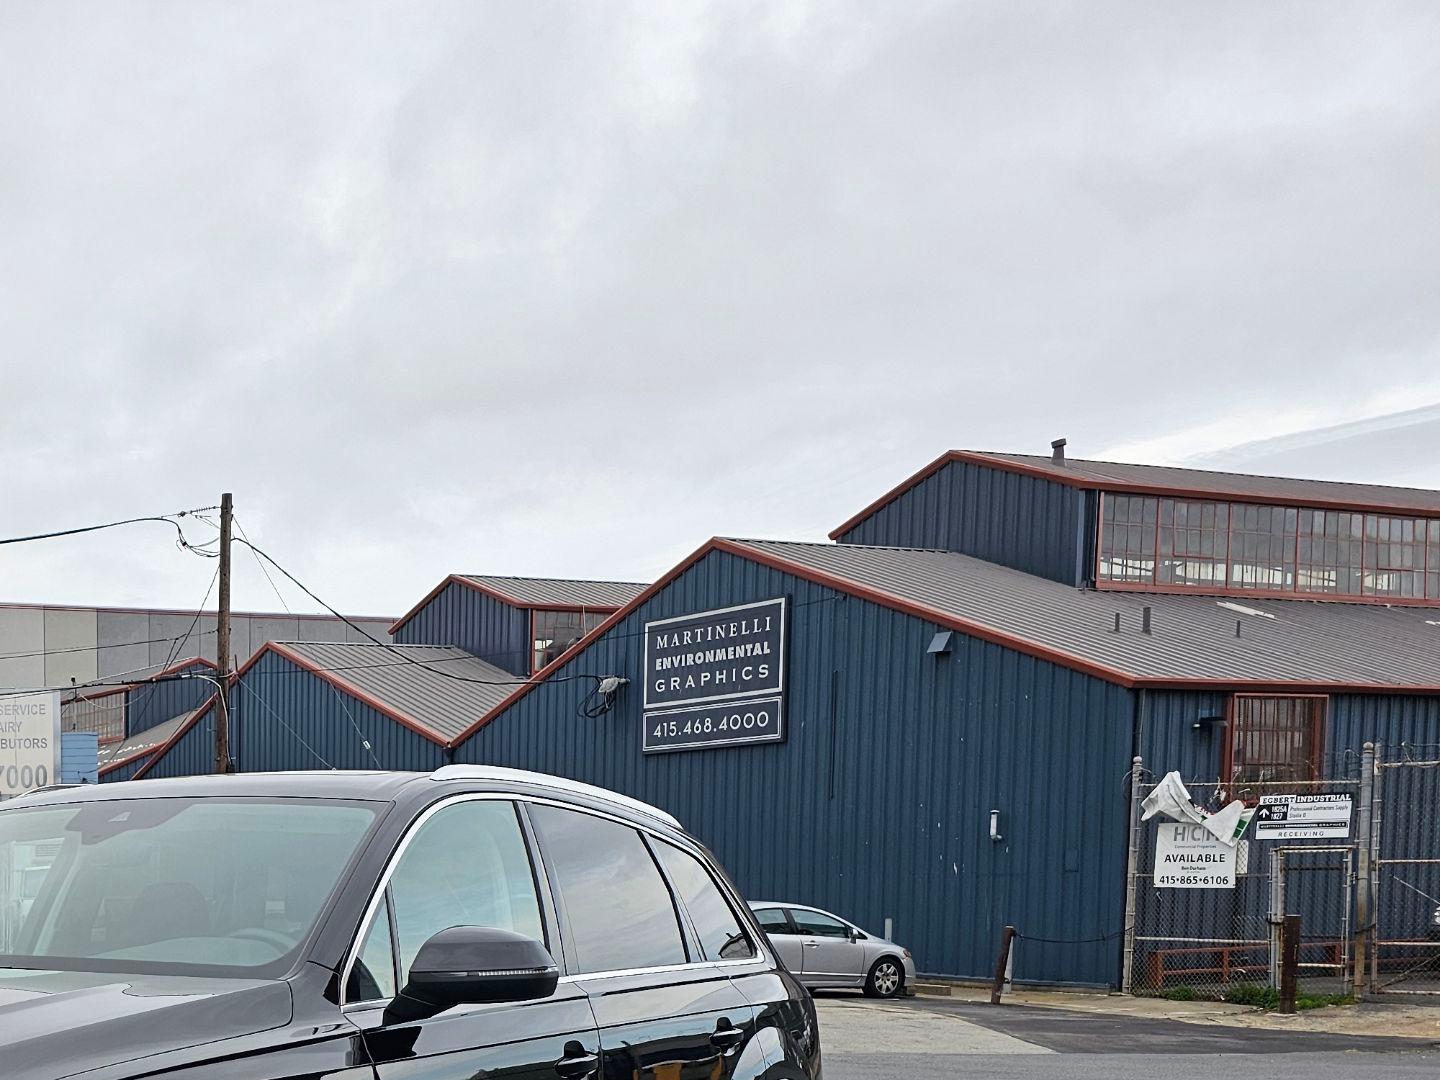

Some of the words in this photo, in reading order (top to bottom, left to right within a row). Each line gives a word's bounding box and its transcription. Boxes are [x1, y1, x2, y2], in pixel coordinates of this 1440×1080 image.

[656, 616, 771, 649] MARTINELLI
[655, 641, 771, 671] ENVIRONMENTAL
[655, 664, 769, 692] GRAPHICS
[653, 711, 769, 738] 415.468.4000
[1262, 796, 1296, 805] EGBERT
[1297, 793, 1352, 803] INDUSTRIAL
[1164, 853, 1226, 863] AVAILABLE
